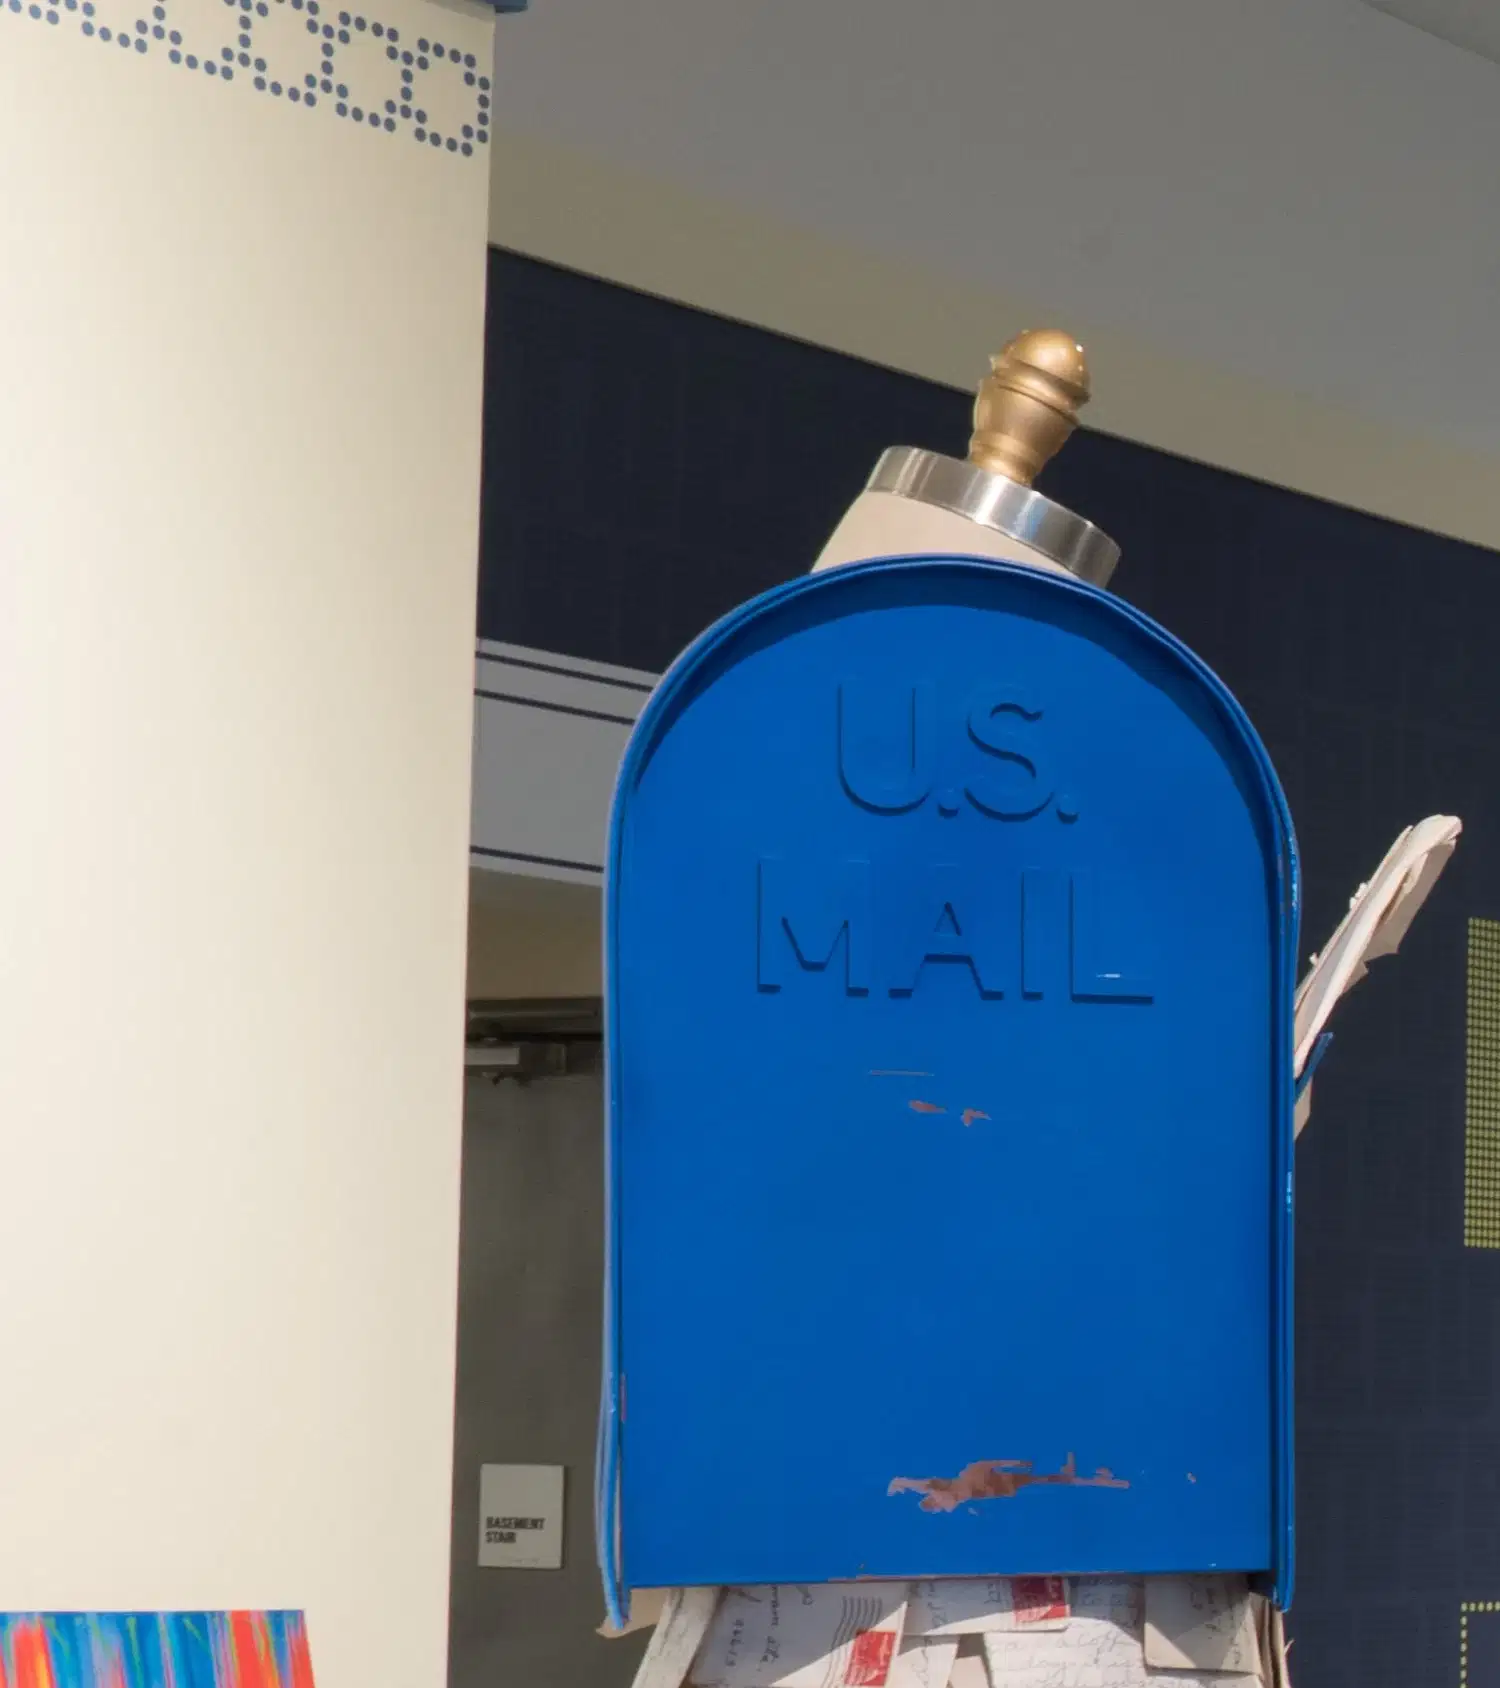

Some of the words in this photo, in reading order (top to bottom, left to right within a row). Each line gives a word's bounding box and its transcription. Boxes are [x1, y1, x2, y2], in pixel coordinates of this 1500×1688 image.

[836, 677, 1081, 824] U.S.
[755, 854, 1154, 1006] MAIL
[485, 1531, 517, 1544] STAIR
[486, 1516, 546, 1530] BASEMENT
